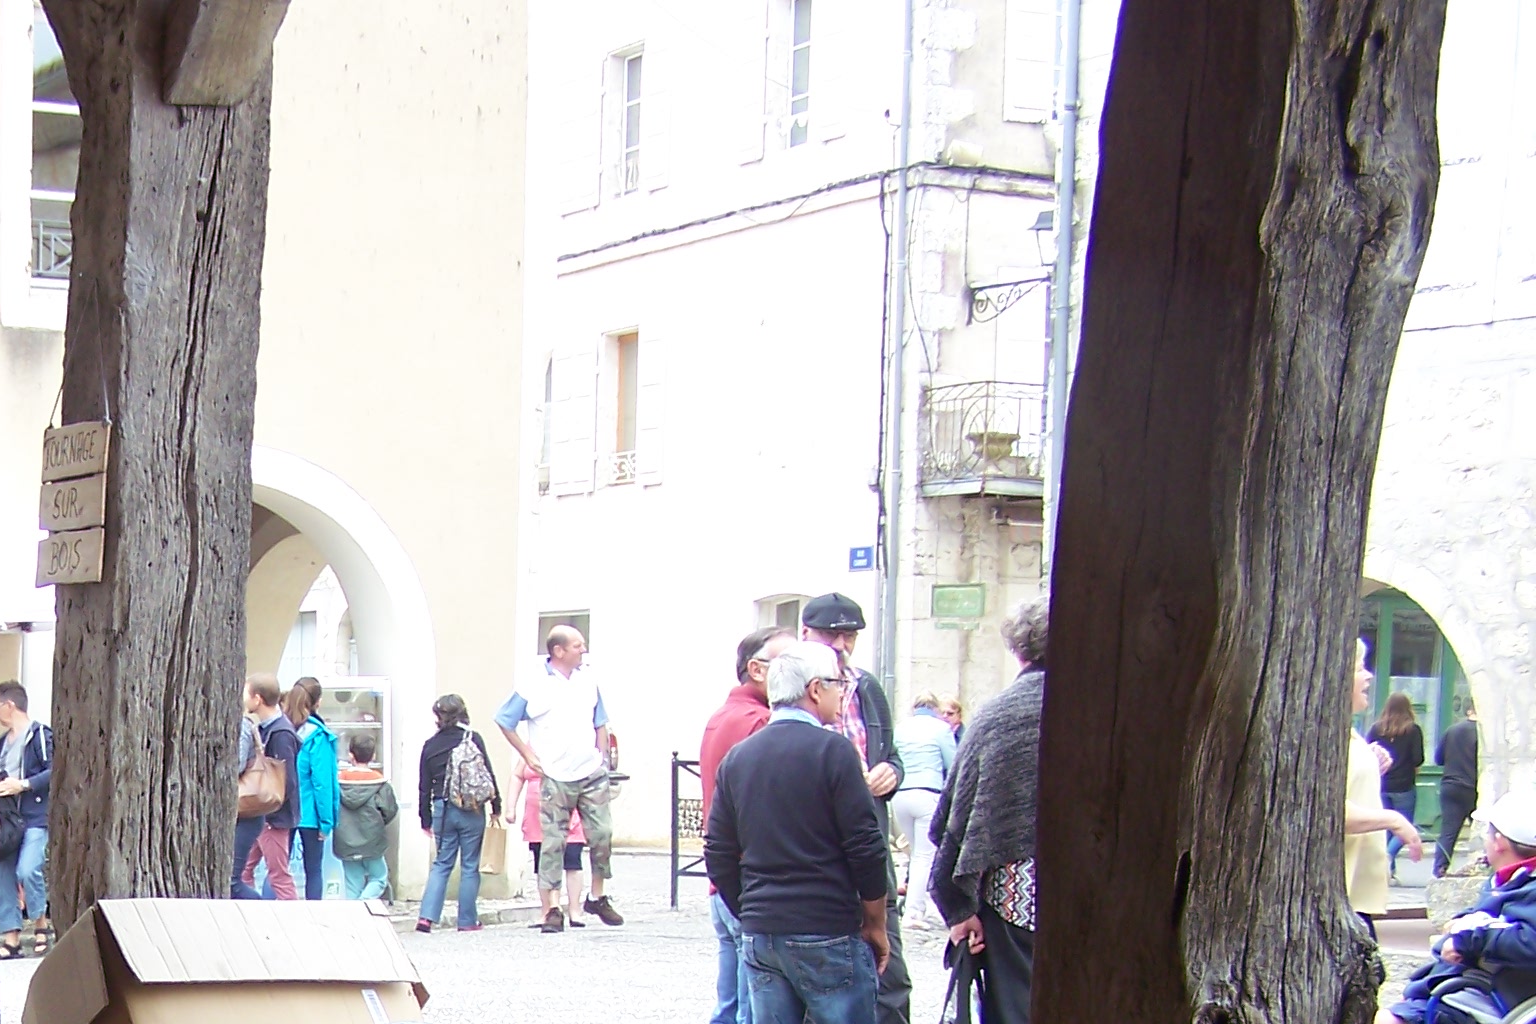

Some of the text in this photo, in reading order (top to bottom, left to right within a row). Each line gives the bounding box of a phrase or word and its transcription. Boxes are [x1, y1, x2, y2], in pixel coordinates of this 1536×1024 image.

[43, 430, 98, 471] TOURNAGE
[52, 487, 79, 520] SUR
[47, 538, 83, 576] BOIS
